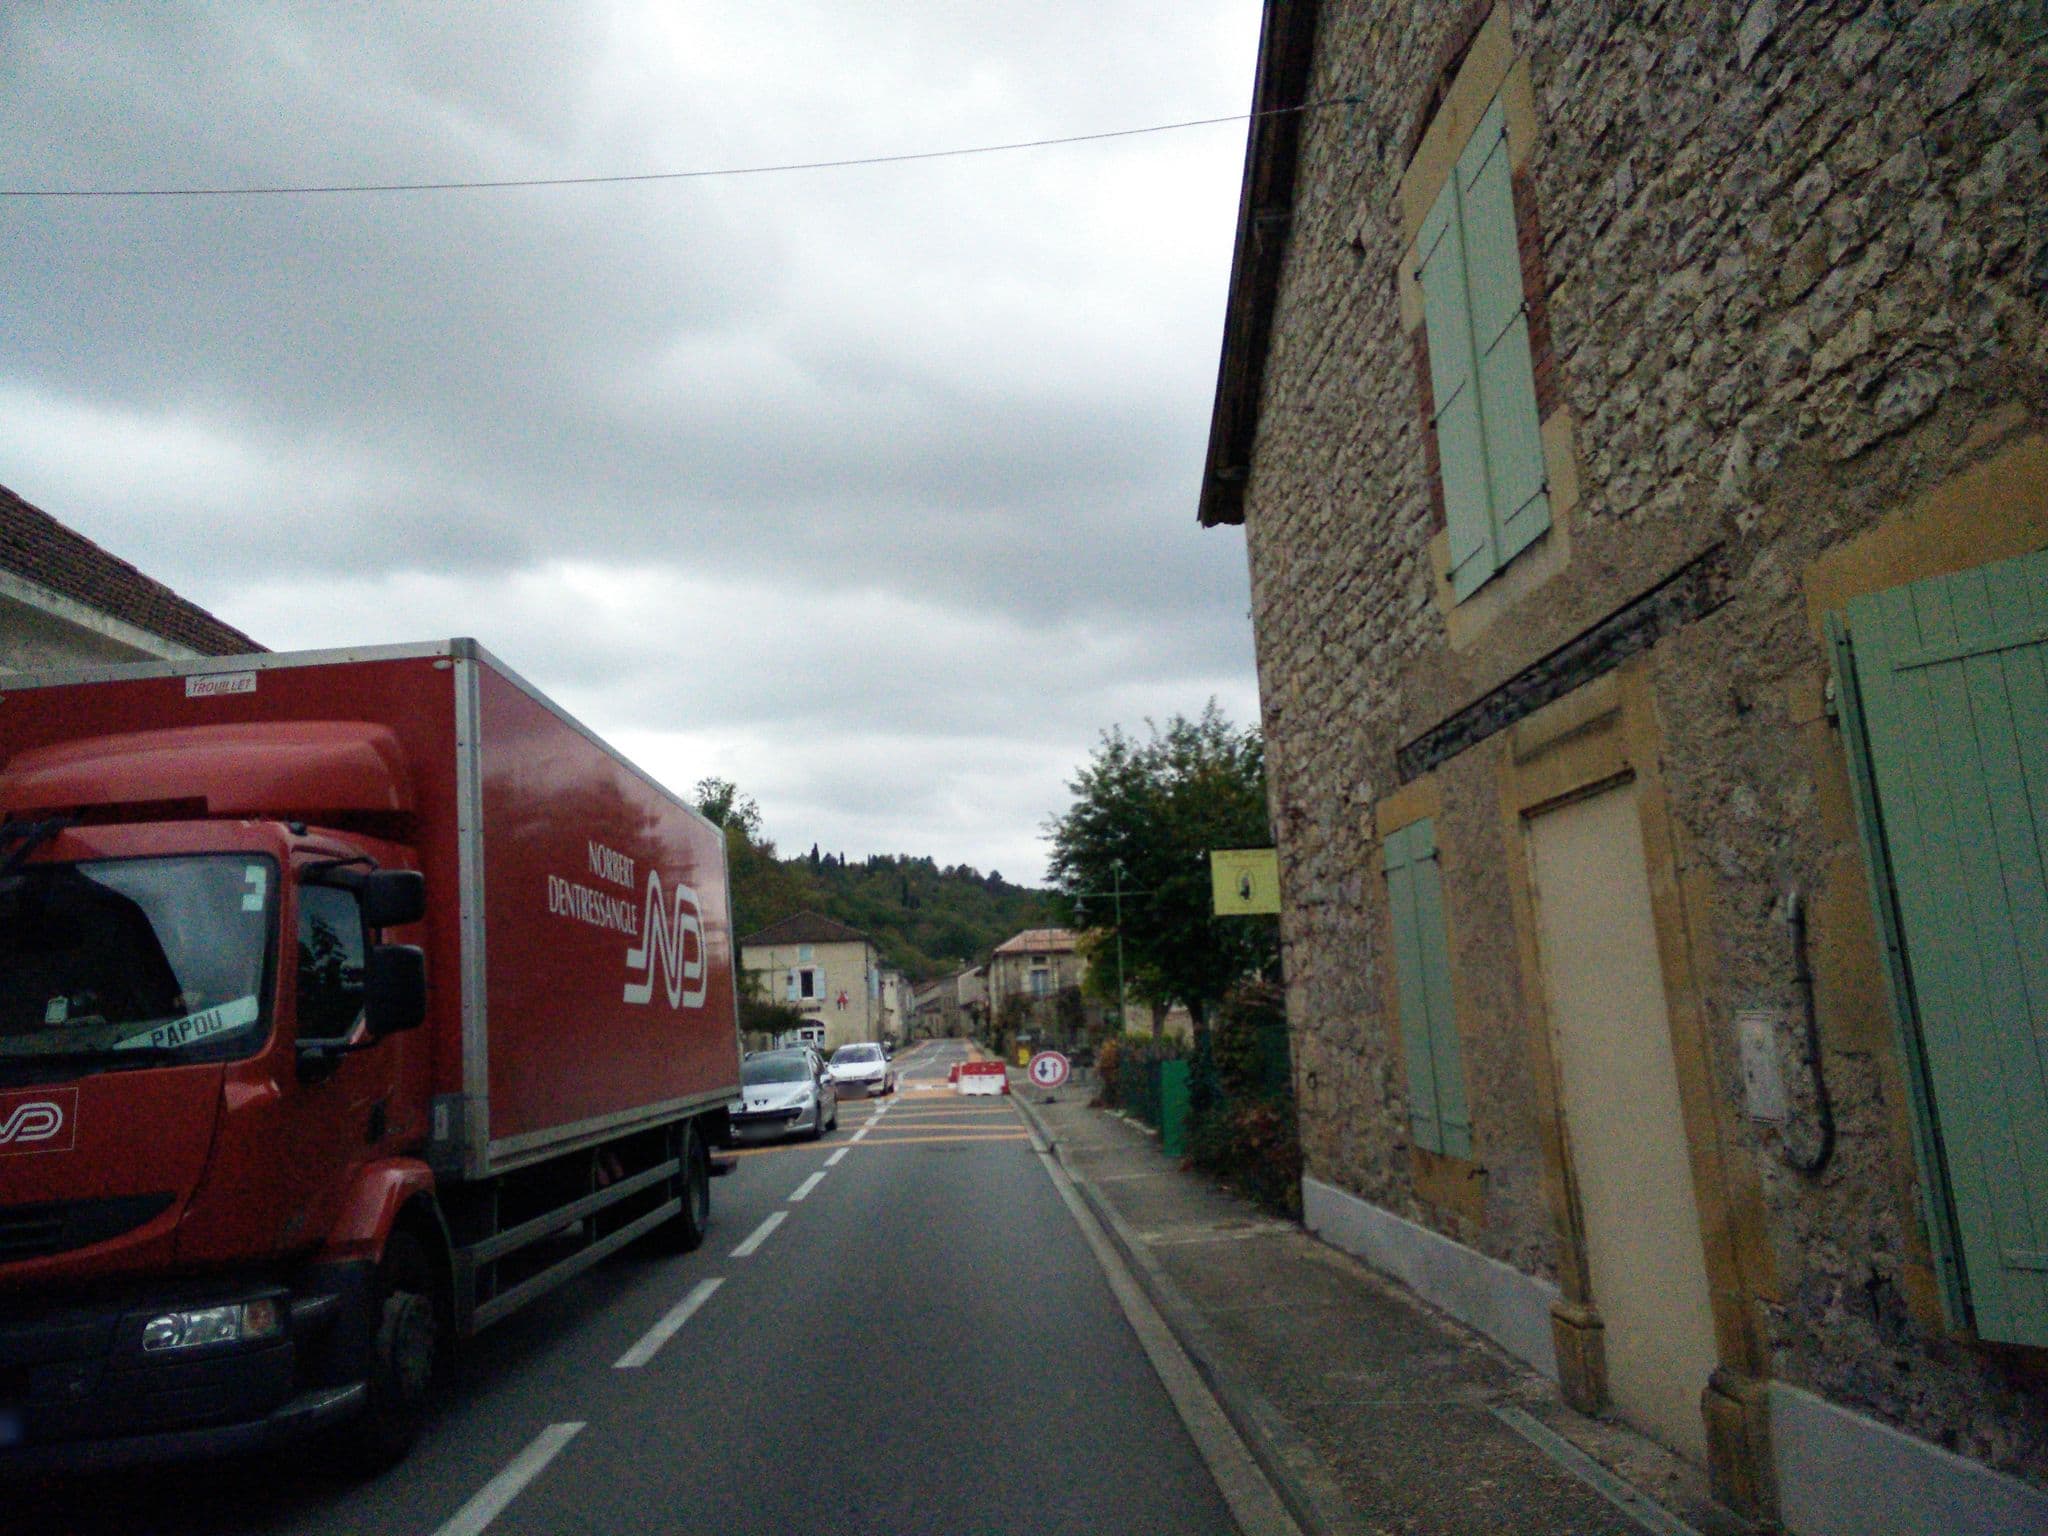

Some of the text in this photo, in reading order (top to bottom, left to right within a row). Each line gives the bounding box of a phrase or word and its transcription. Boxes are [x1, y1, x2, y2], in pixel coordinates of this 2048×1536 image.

[588, 840, 635, 888] NORBERT
[548, 874, 638, 935] DENTRESSANGLE
[151, 1010, 223, 1047] PAPOU
